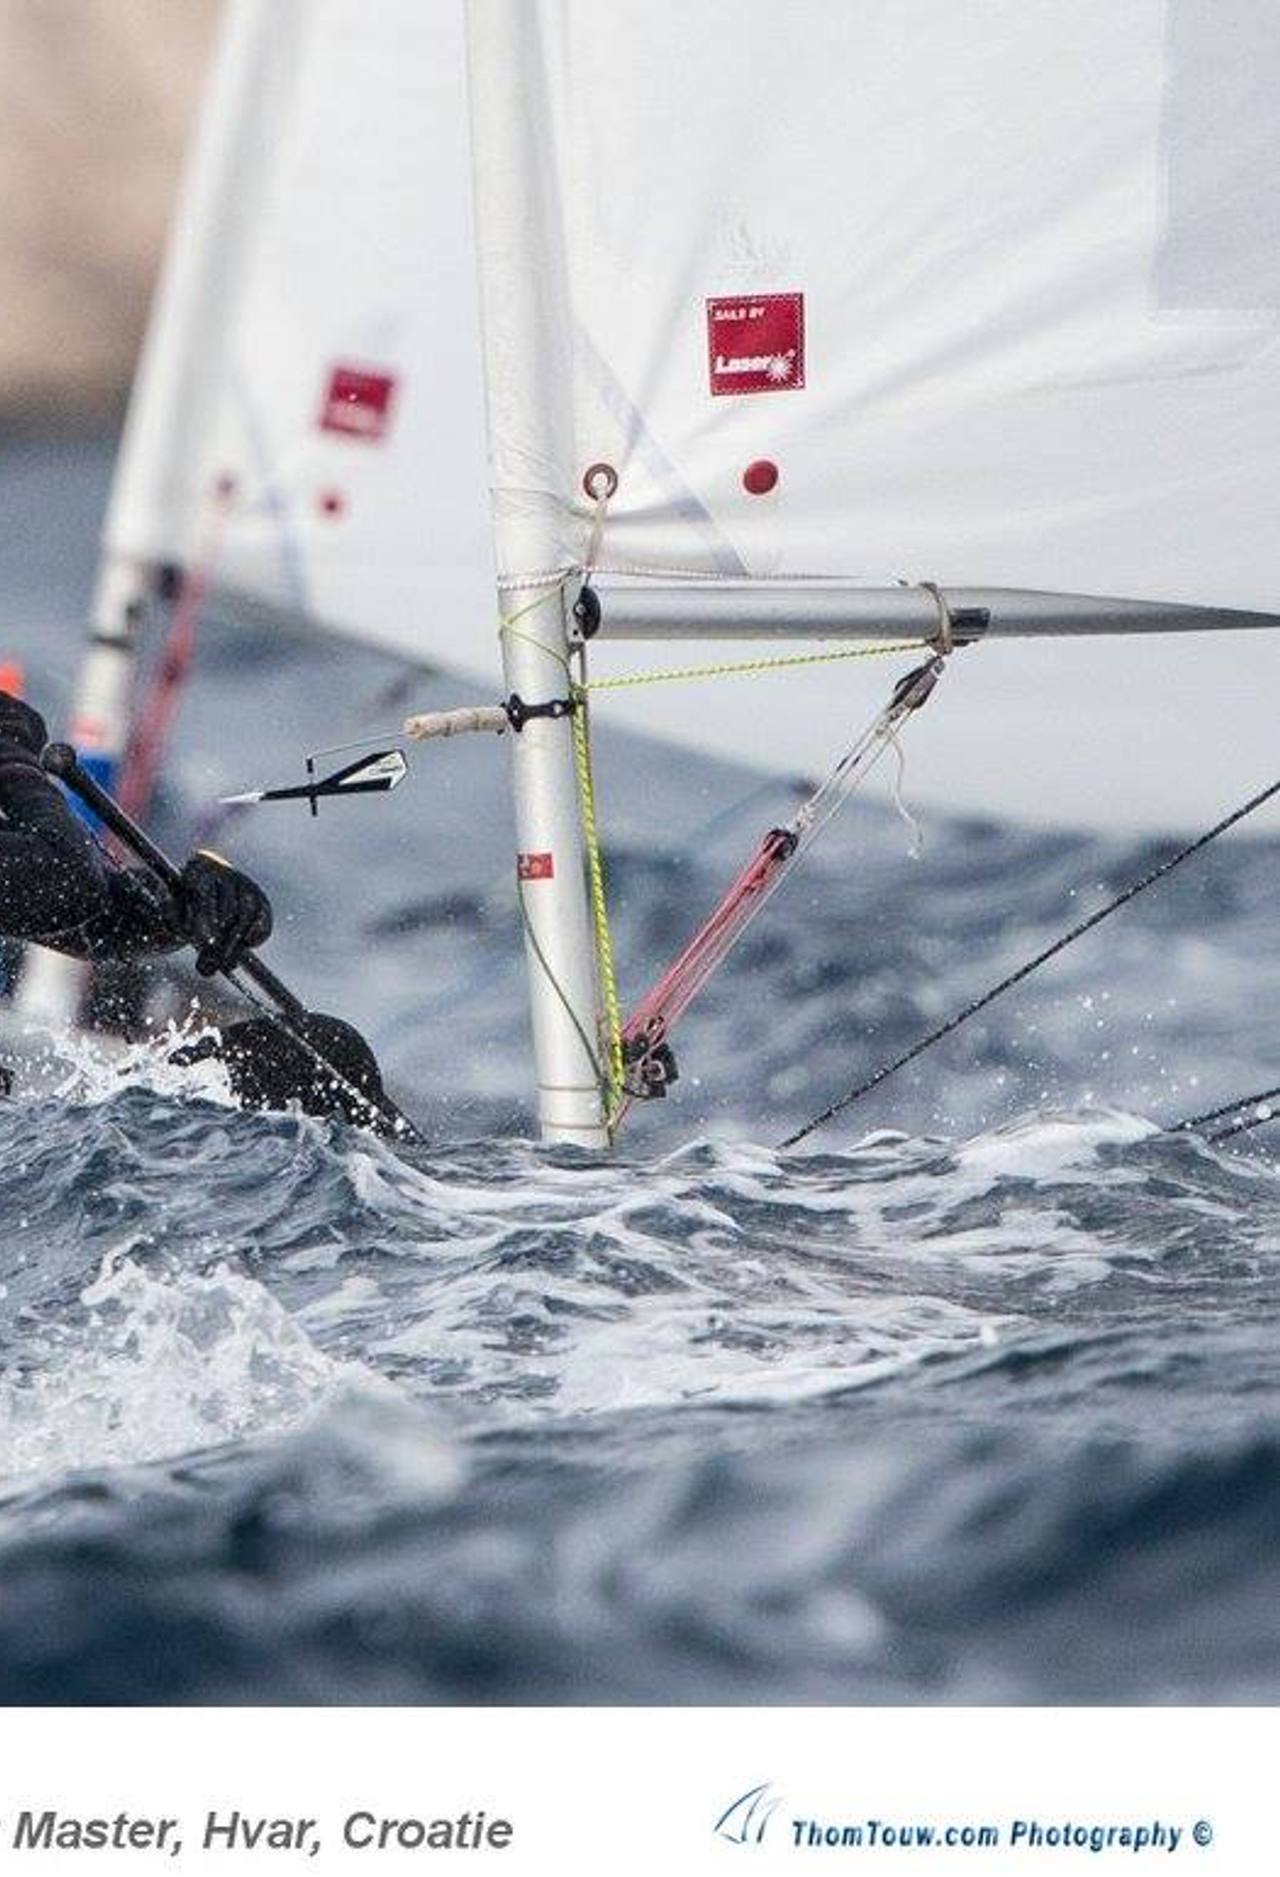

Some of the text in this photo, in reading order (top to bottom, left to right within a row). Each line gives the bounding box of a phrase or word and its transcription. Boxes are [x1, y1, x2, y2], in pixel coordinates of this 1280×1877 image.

[714, 306, 766, 321] SAILS BY
[714, 355, 771, 375] Laser
